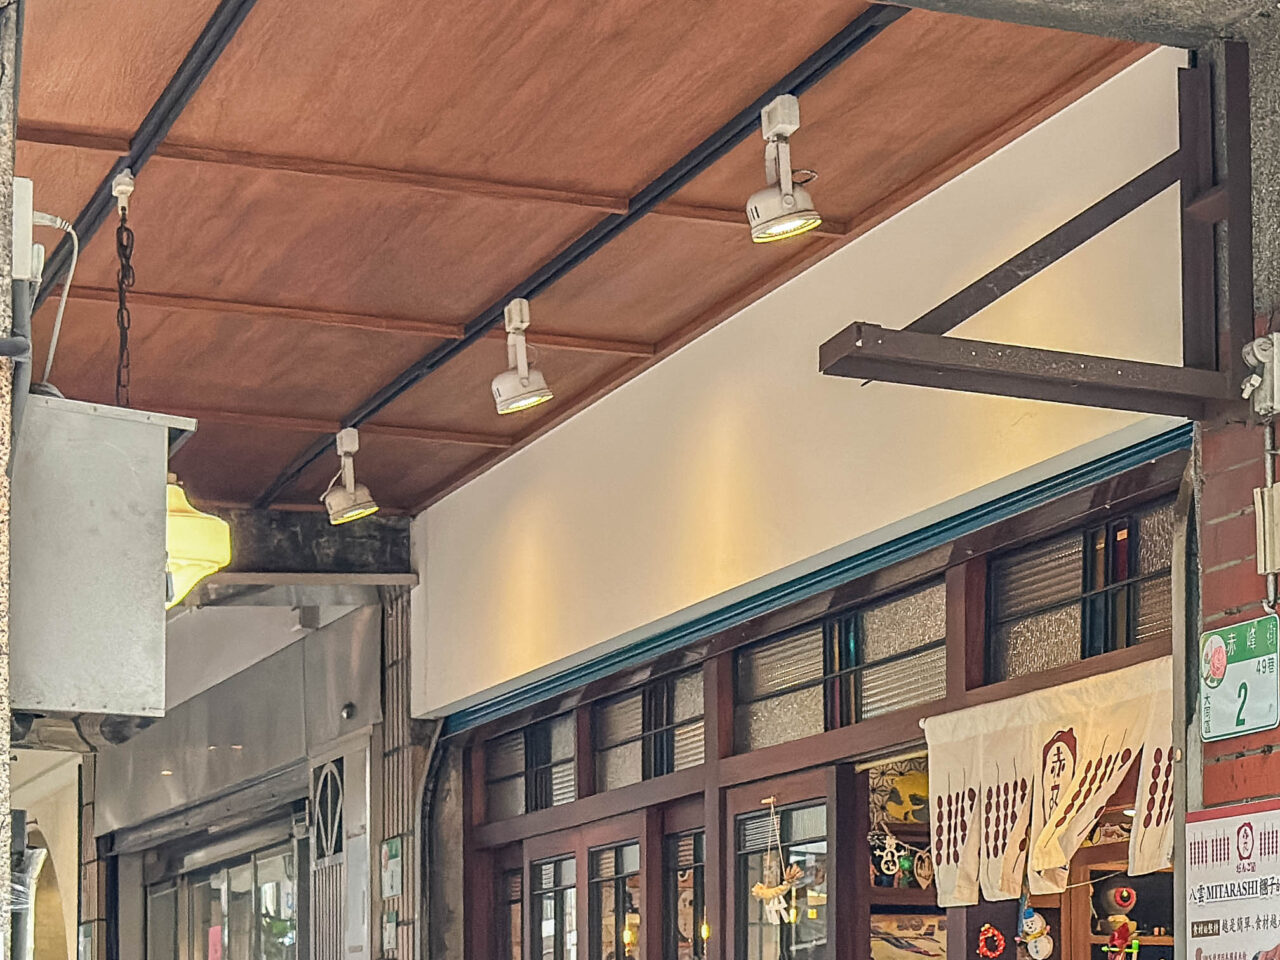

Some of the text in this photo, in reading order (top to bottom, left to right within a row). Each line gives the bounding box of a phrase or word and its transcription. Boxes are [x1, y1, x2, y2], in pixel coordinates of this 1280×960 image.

[1227, 620, 1277, 656] 赤峰街
[1256, 656, 1275, 674] 49巷
[1235, 681, 1248, 727] 2
